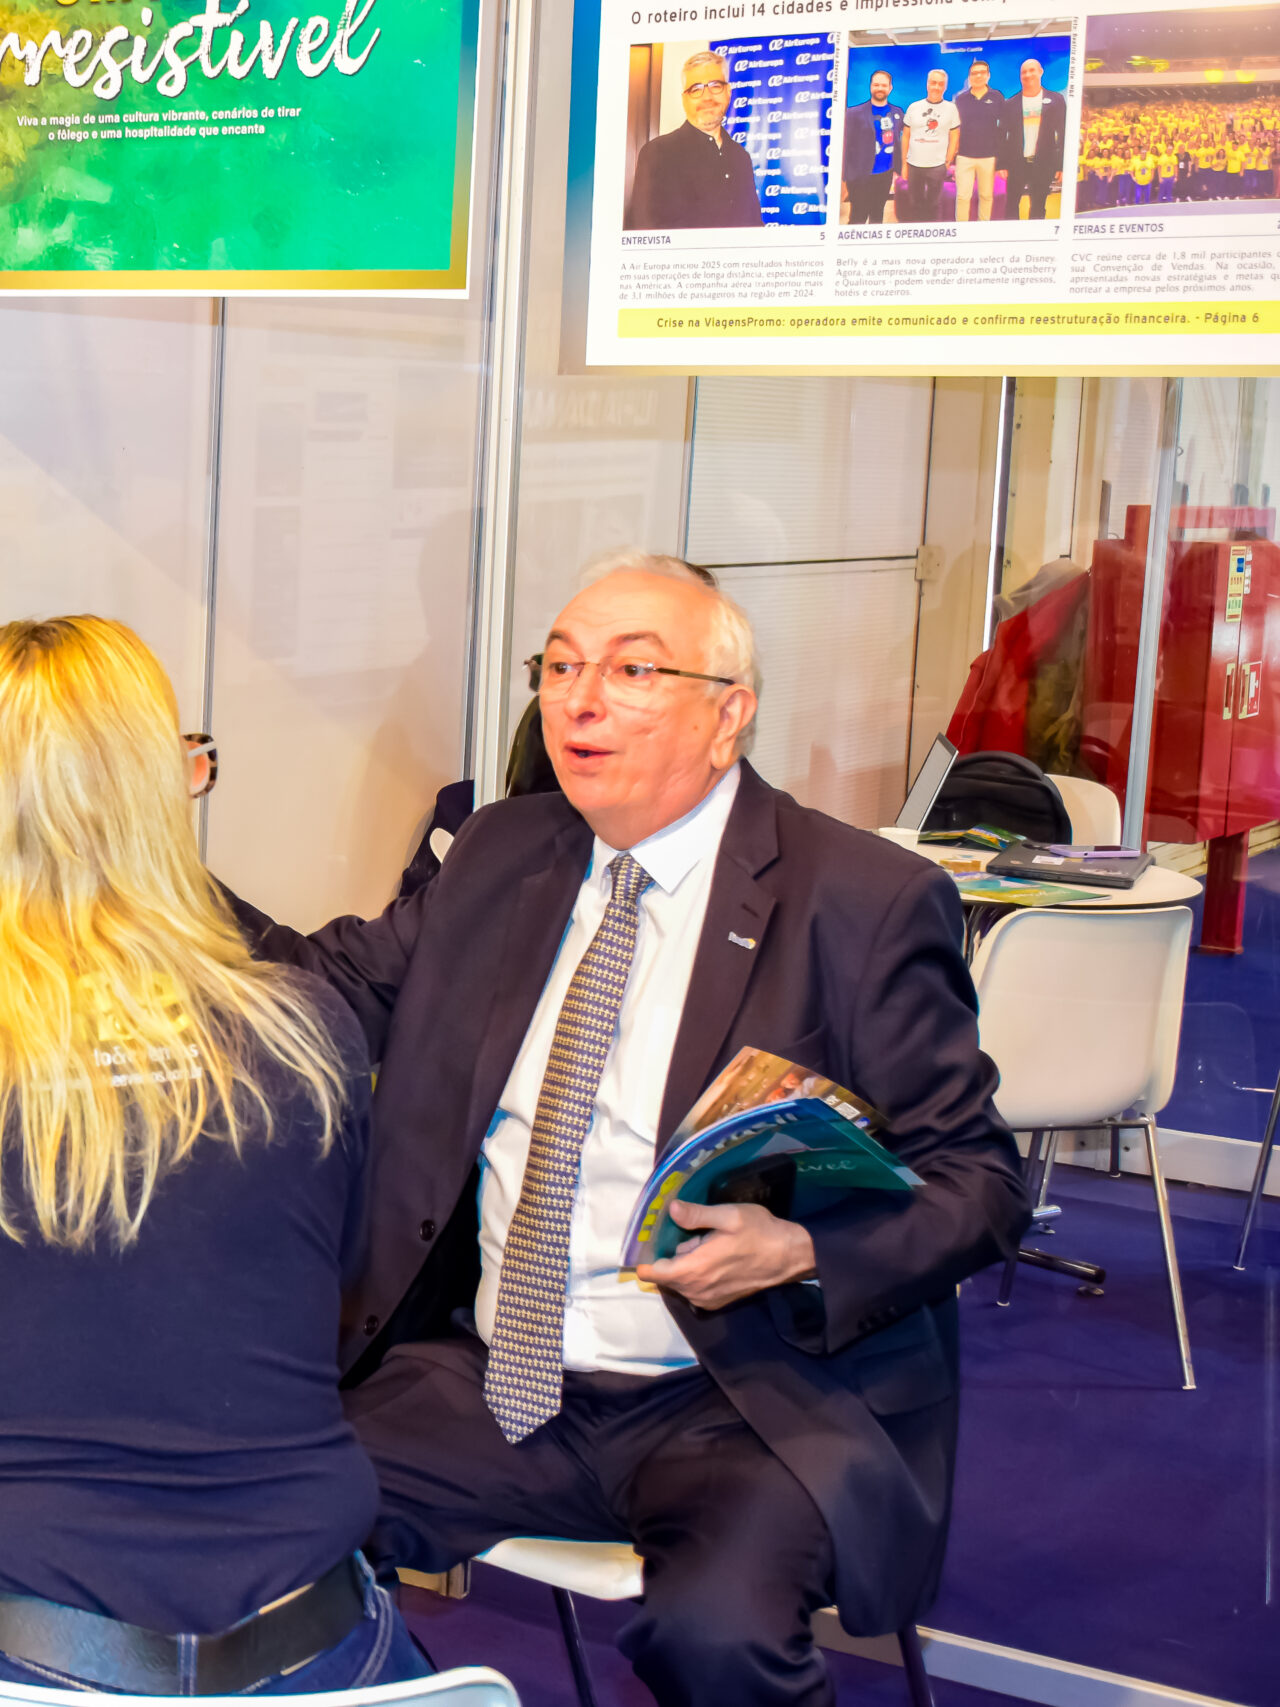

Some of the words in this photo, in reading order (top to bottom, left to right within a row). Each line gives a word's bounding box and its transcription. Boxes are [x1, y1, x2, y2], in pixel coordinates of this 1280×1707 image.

[631, 12, 641, 24] O
[647, 8, 698, 23] roteiro
[704, 4, 745, 20] inclui
[752, 3, 766, 16] 14
[772, 0, 832, 15] cidades
[839, 1, 848, 10] e
[17, 116, 39, 127] Viva
[41, 117, 48, 125] a
[50, 114, 80, 128] magia
[83, 113, 96, 124] de
[98, 114, 120, 124] uma
[123, 111, 159, 123] cultura
[162, 110, 209, 122] vibrante,
[212, 107, 258, 120] cenários
[261, 107, 275, 118] de
[277, 106, 301, 118] tirar
[48, 132, 56, 141] o
[58, 129, 90, 143] fôlego
[92, 130, 99, 139] e
[100, 130, 122, 139] uma
[125, 125, 196, 138] hospitalidade
[199, 127, 219, 138] que
[222, 124, 265, 135] encanta
[838, 229, 883, 240] AGÊNCIAS
[886, 230, 891, 239] E
[894, 228, 957, 239] OPERADORAS
[1053, 225, 1060, 235] 7
[1073, 224, 1106, 234] FEIRAS
[1109, 224, 1115, 233] E
[1119, 223, 1164, 233] EVENTOS
[621, 236, 671, 245] ENTREVISTA
[820, 232, 825, 240] 5
[643, 262, 670, 272] Europa
[701, 261, 721, 269] 2025
[723, 261, 740, 269] com
[742, 260, 782, 269] resultados
[785, 259, 824, 268] históricos
[657, 318, 684, 328] Crise
[688, 319, 700, 328] na
[704, 317, 785, 330] ViagensPromo:
[790, 317, 846, 329] operadora
[851, 316, 883, 326] emite
[887, 315, 957, 326] comunicado
[961, 317, 969, 325] e
[973, 314, 1025, 325] confirma
[1030, 313, 1120, 327] reestruturação
[1204, 312, 1247, 326] Página
[1252, 313, 1259, 323] 6
